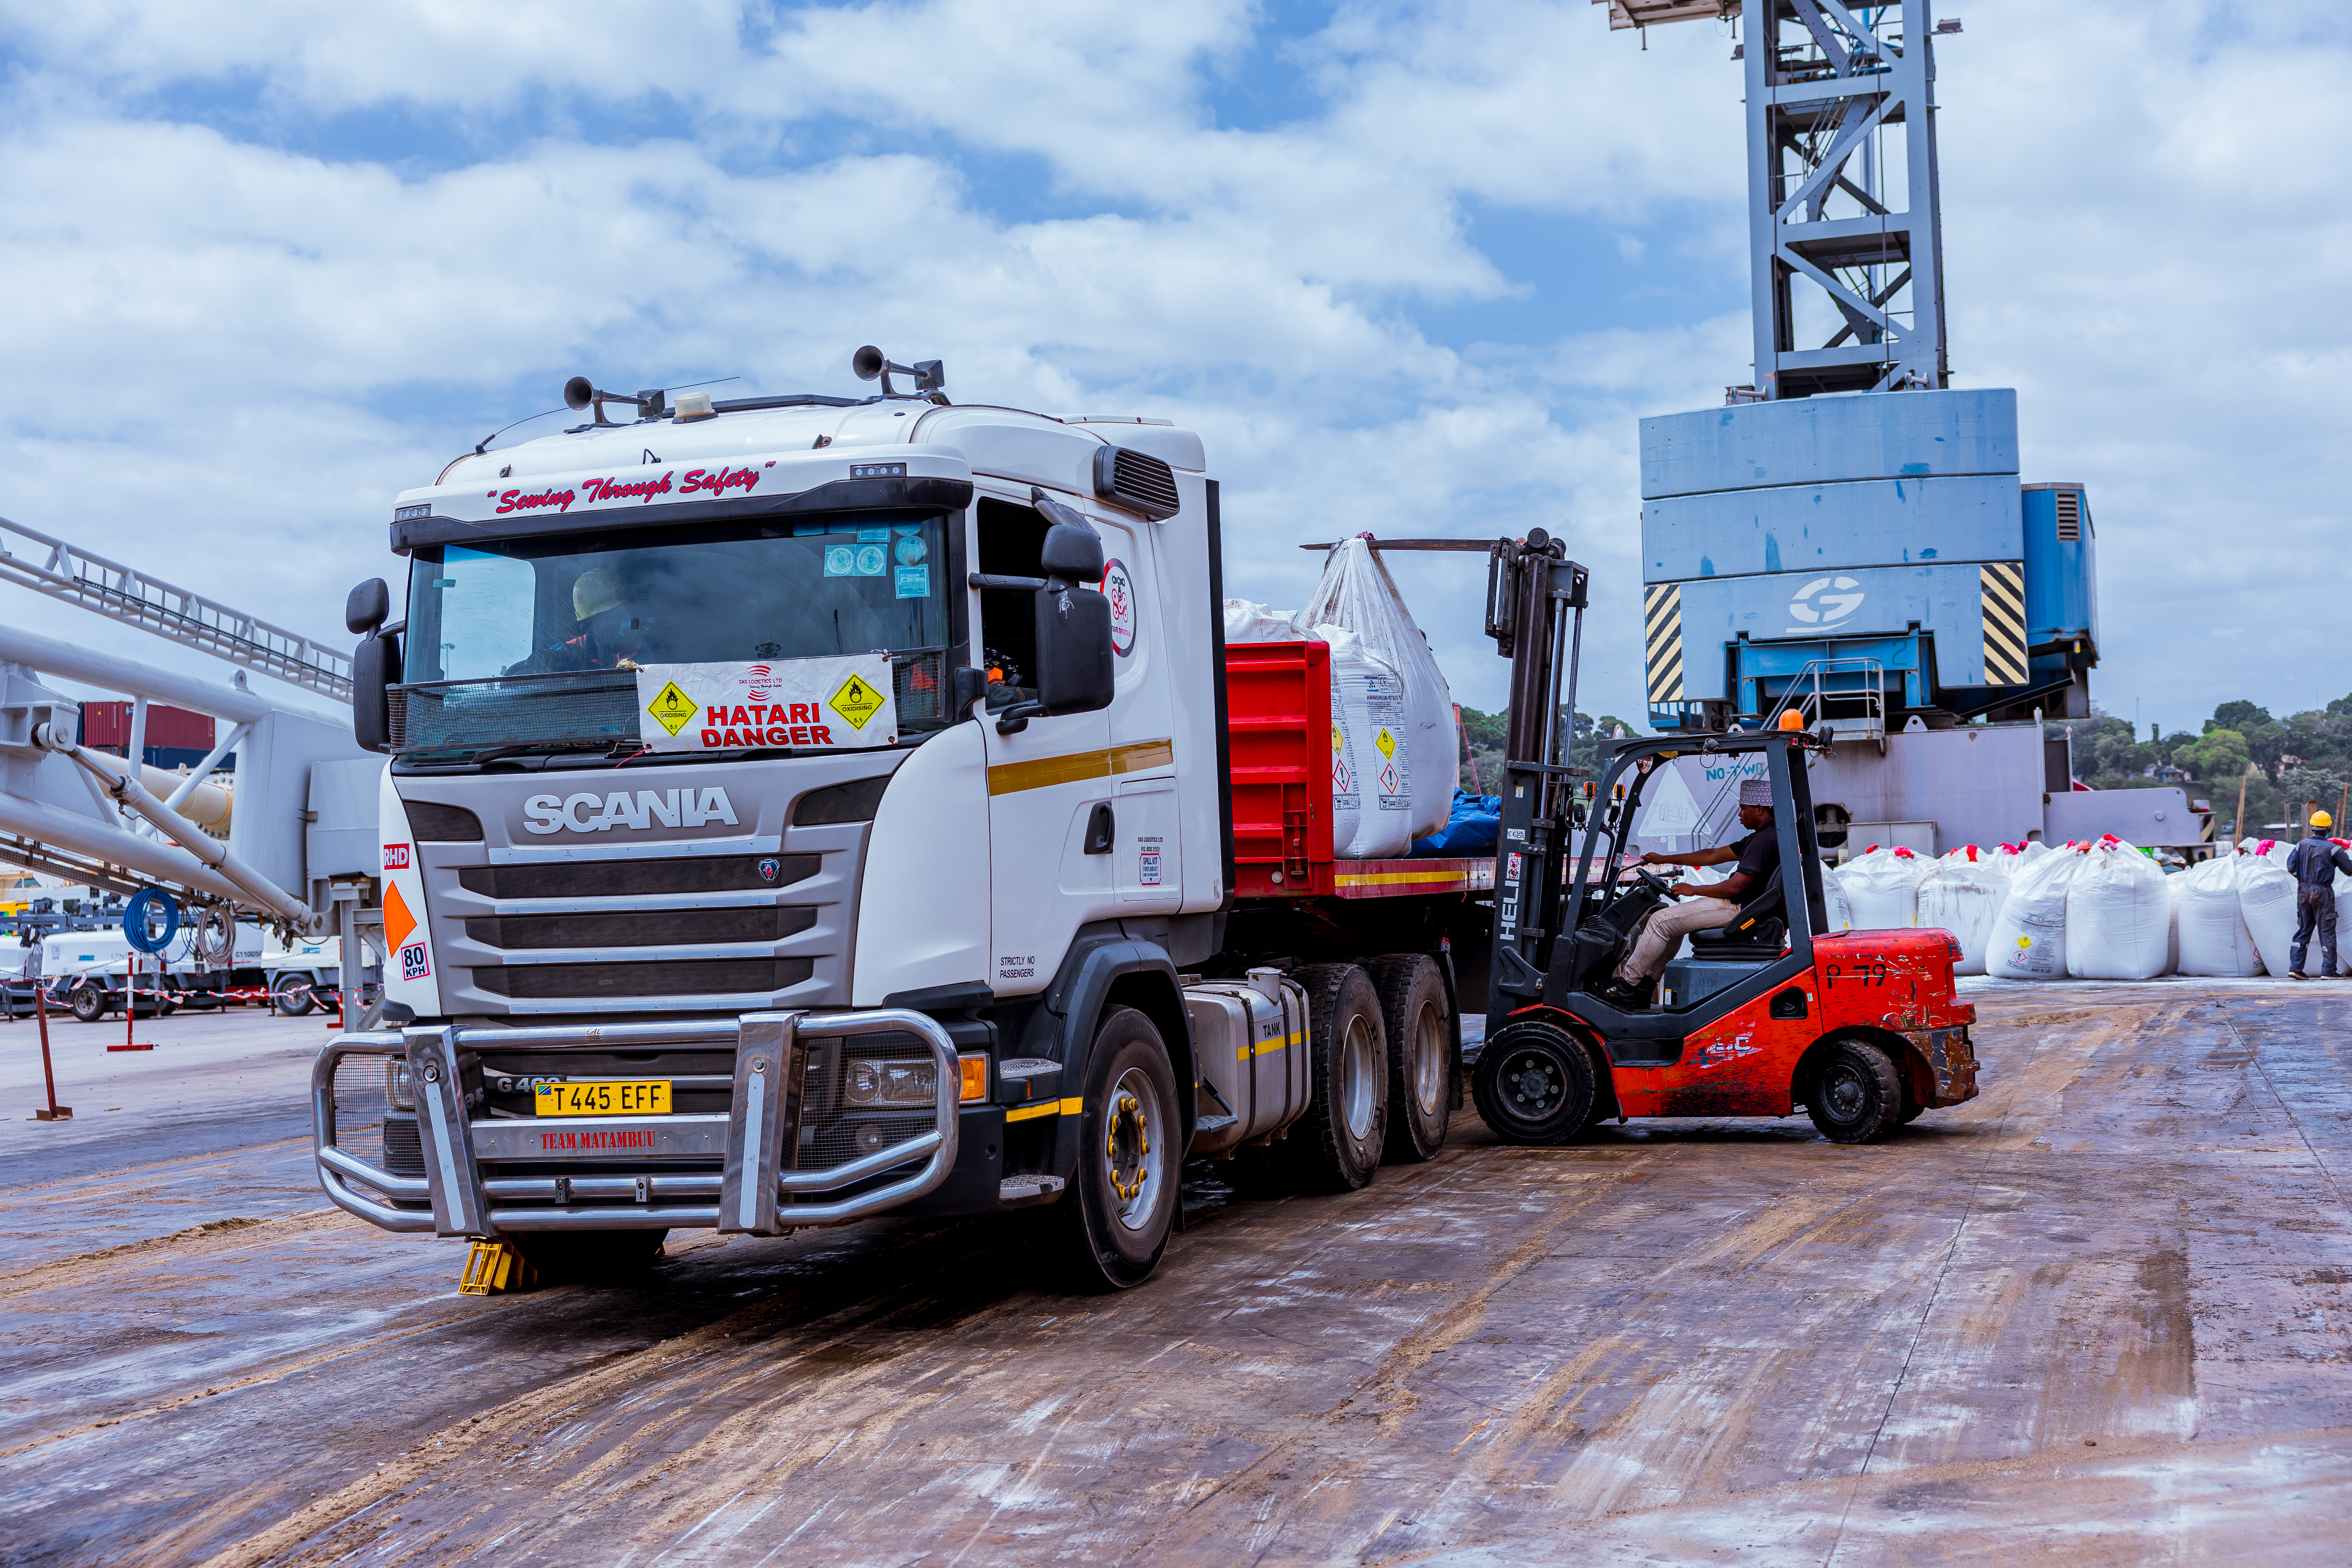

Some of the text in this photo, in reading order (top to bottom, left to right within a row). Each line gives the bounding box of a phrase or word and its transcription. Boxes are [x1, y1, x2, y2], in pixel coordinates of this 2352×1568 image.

[581, 470, 674, 503] Through
[1892, 639, 1908, 666] 2
[707, 702, 820, 726] HATARI
[701, 726, 834, 748] DANGER
[523, 786, 740, 835] SCANIA
[384, 847, 408, 866] RHD
[1500, 880, 1520, 941] HELI
[404, 946, 424, 967] 80
[1000, 956, 1035, 966] STRICTLY NO
[405, 965, 426, 978] KPH
[1000, 968, 1034, 979] PASSENGERS
[1826, 964, 1887, 989] P 79
[1263, 1022, 1281, 1038] TANK
[497, 1078, 512, 1093] G
[554, 1085, 661, 1111] T 445 EFF
[540, 1131, 656, 1150] TEAM MATAMBUU
